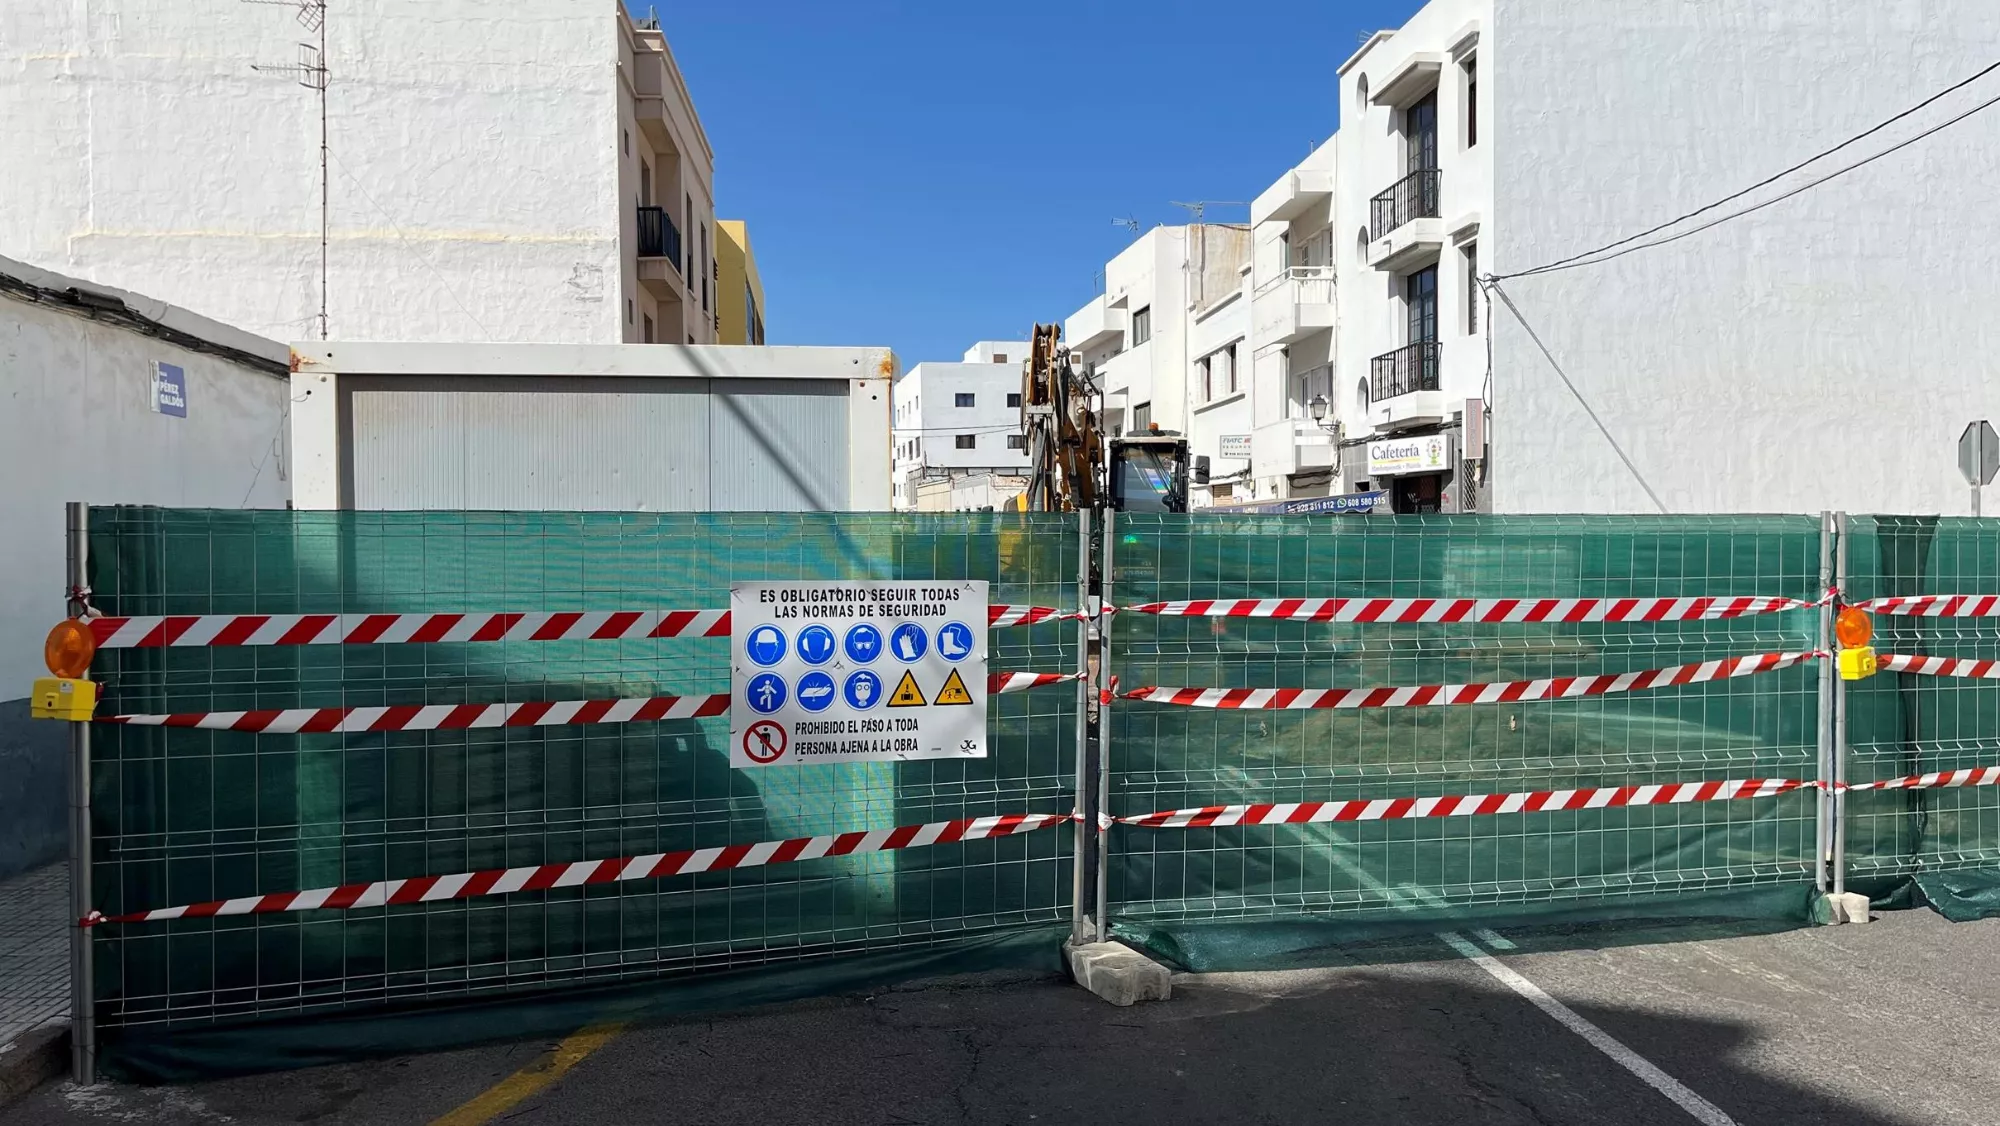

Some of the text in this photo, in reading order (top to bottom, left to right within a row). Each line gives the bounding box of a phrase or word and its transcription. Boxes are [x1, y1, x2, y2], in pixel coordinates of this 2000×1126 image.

[160, 380, 179, 395] PÉREZ
[160, 394, 184, 408] GALDÓS
[1371, 443, 1420, 460] Cafetería
[1322, 501, 1334, 509] 812
[1347, 498, 1359, 507] 608
[1360, 497, 1372, 506] 580
[1373, 496, 1386, 505] 515
[760, 588, 960, 603] ES OBLIGATORIO SEGUIR TODAS
[774, 603, 947, 618] LAS NORMAS DE SEGURIDAD
[795, 718, 919, 735] PROHIBIDO EL PASO A TODA
[795, 738, 919, 755] PERSONA AJENA A LA OBRA
